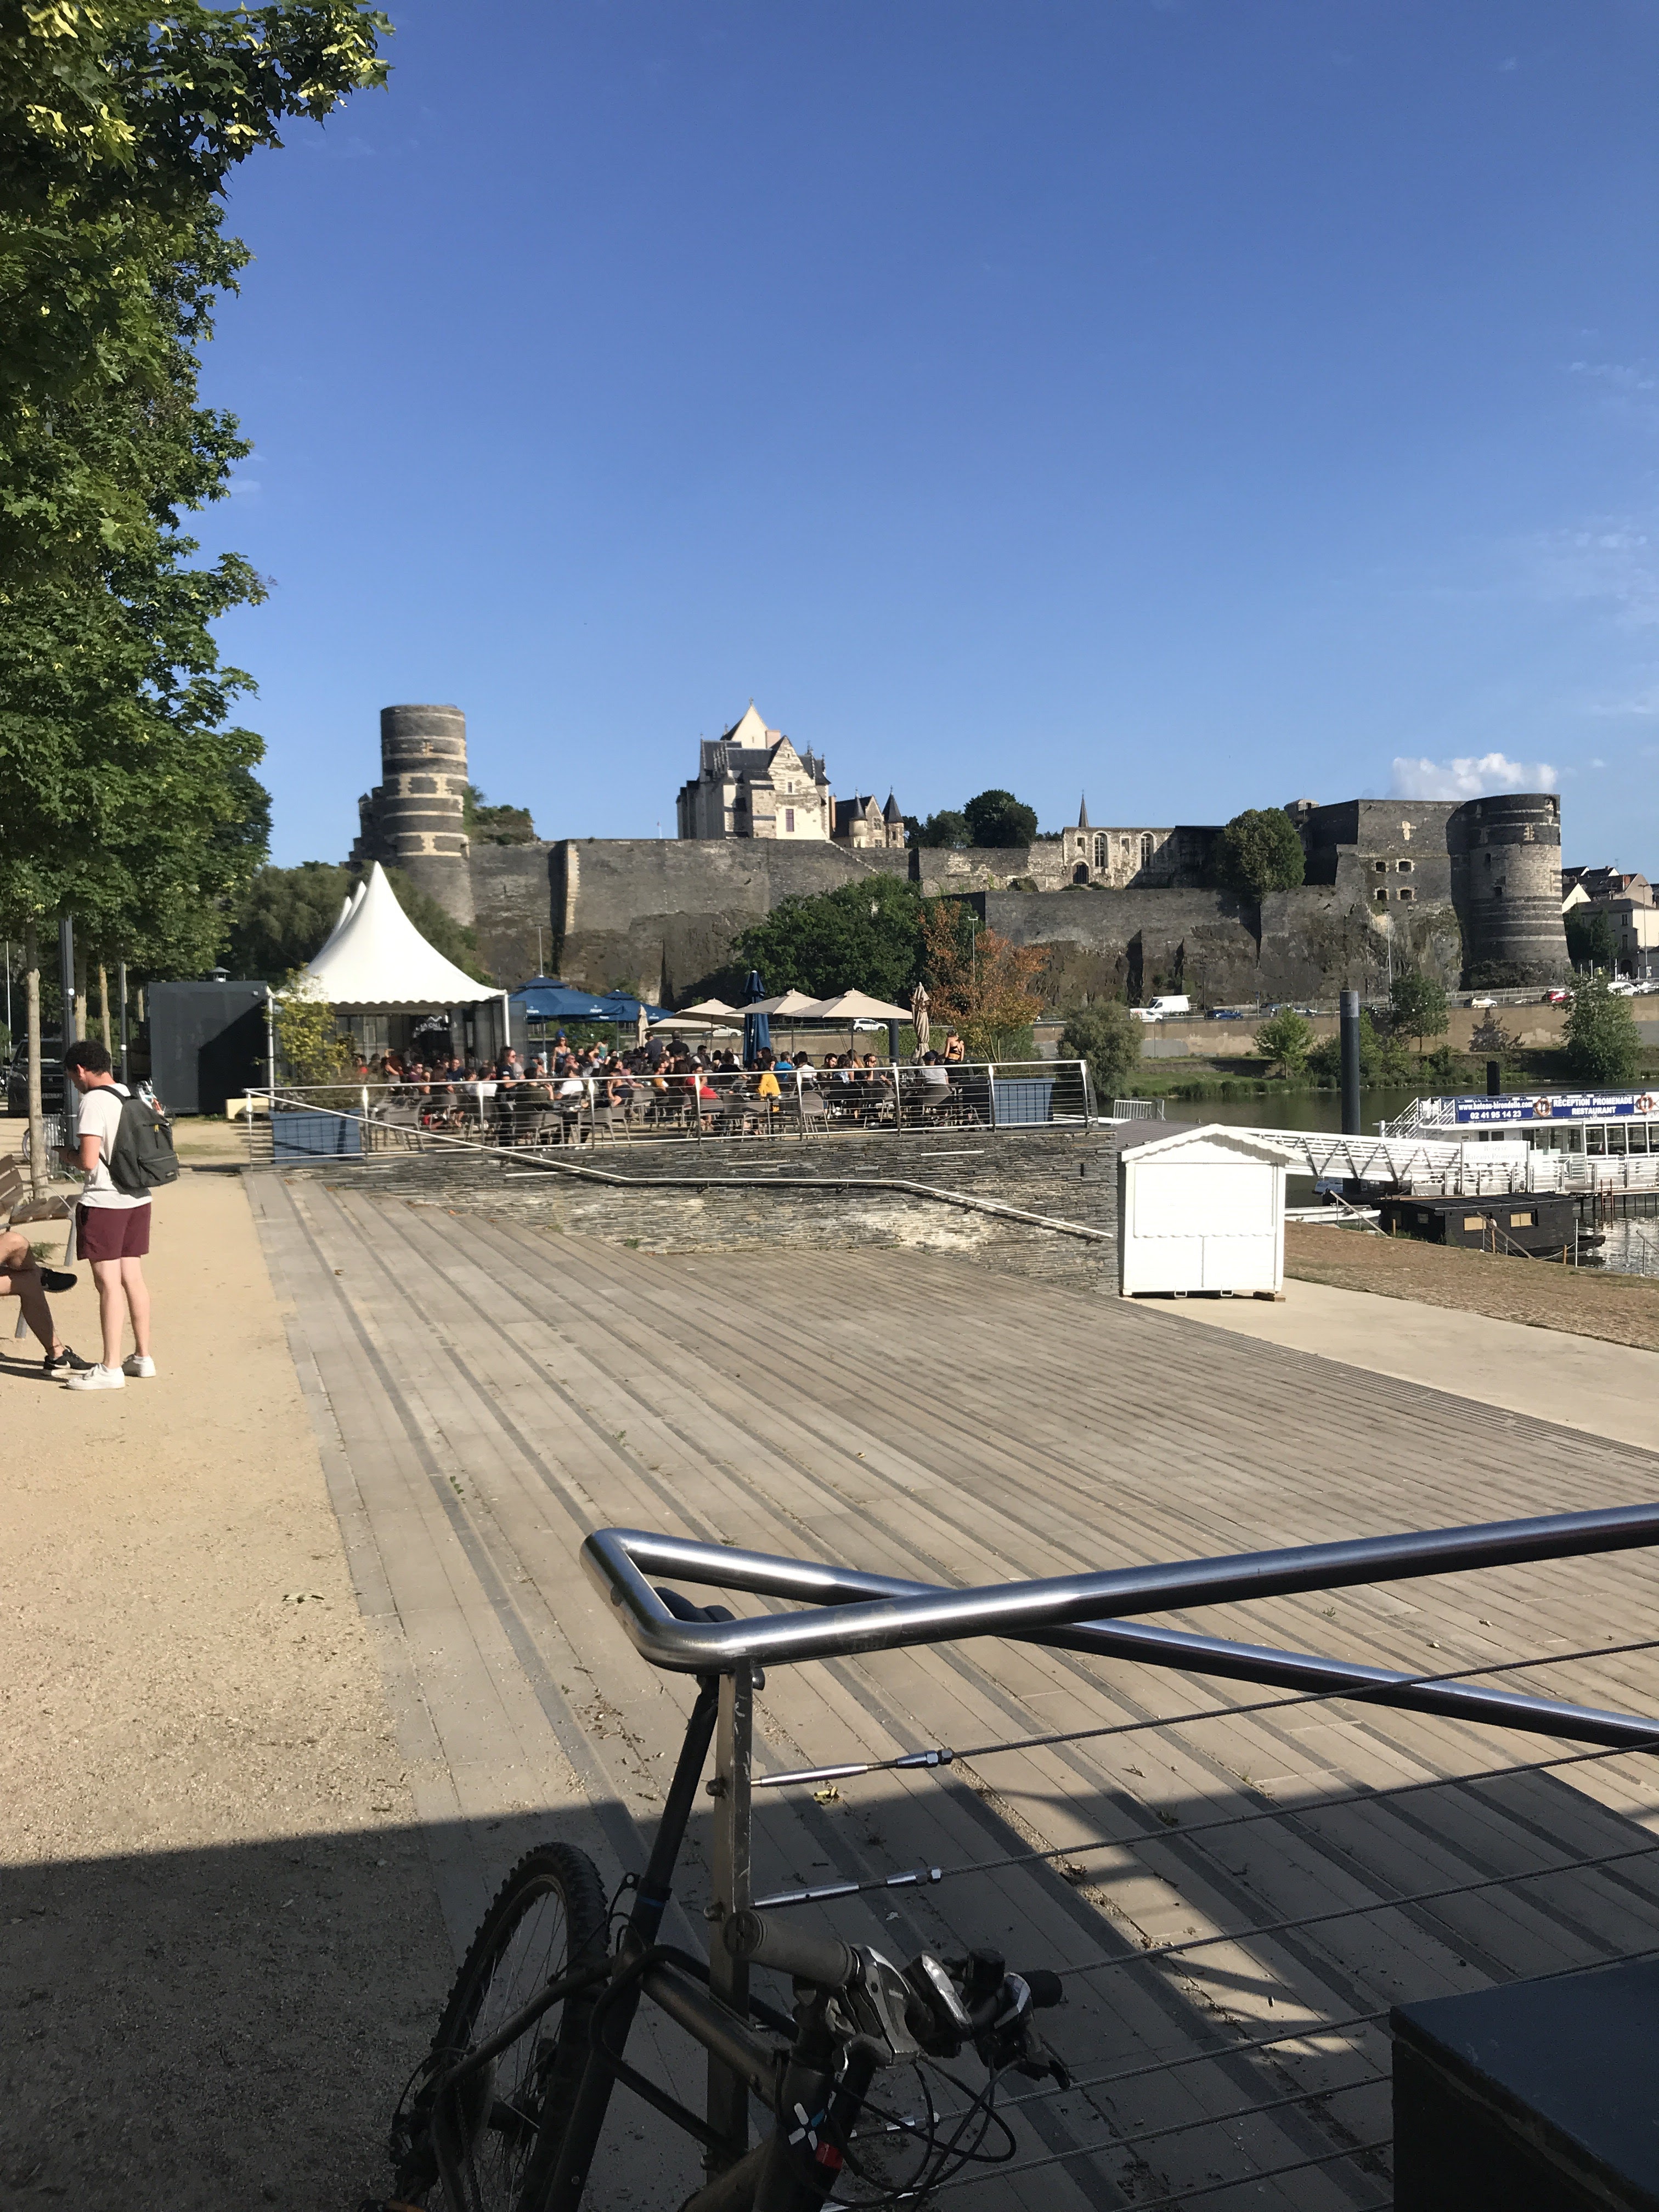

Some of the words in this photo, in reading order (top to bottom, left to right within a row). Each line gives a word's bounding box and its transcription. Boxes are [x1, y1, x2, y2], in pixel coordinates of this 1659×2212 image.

[1593, 1096, 1633, 1105] PROMENADE
[1458, 1101, 1533, 1110] www.bateau-hirondelle.com
[1572, 1107, 1616, 1115] RESTAURANT
